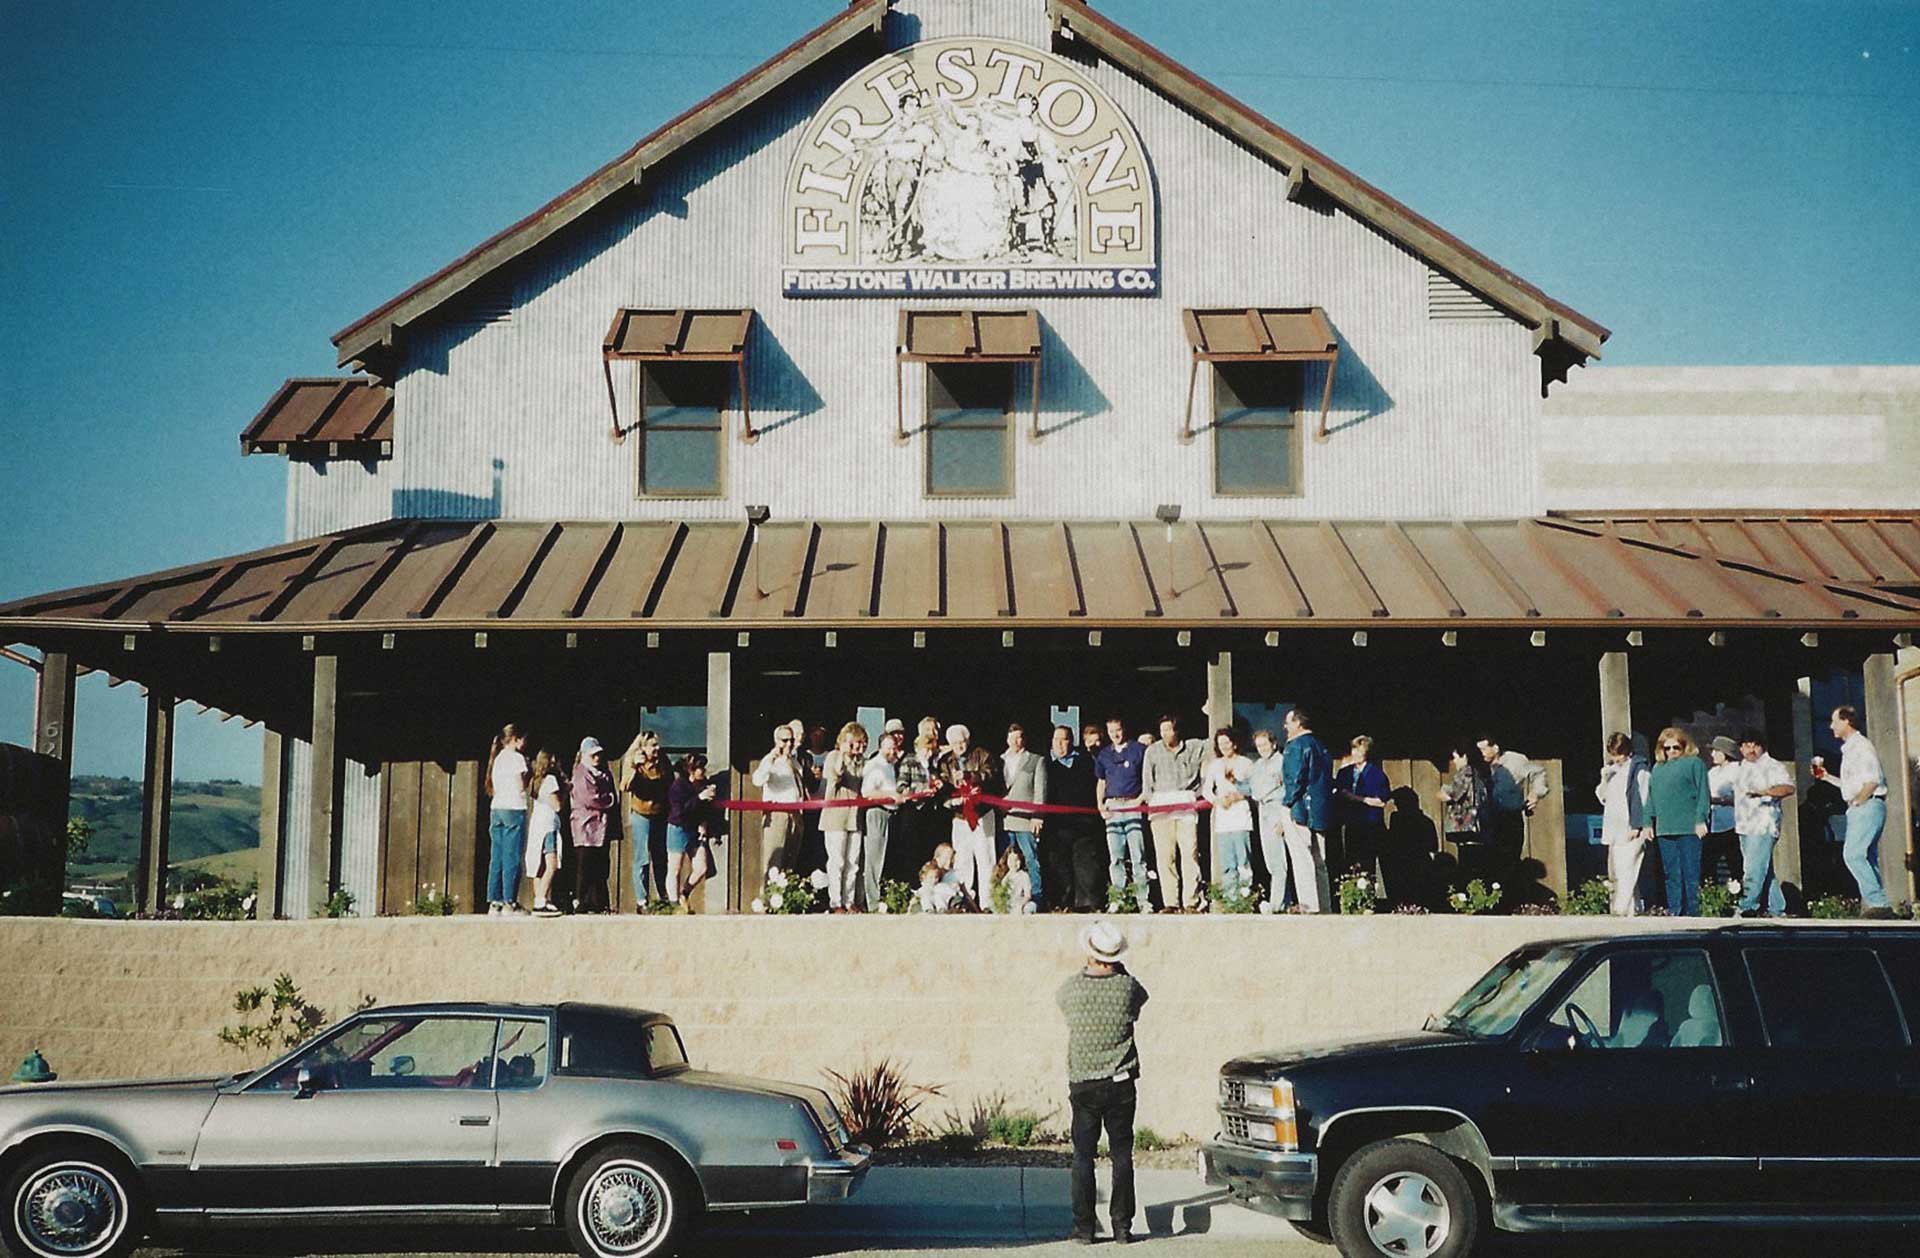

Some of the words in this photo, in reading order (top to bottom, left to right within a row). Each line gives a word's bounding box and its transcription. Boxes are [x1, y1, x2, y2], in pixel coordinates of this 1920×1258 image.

[796, 48, 1142, 254] FIRESTONE
[784, 270, 906, 289] FIRESTONE
[908, 270, 1007, 289] WALKER
[1009, 269, 1115, 290] BREWING
[1117, 269, 1155, 289] CO.
